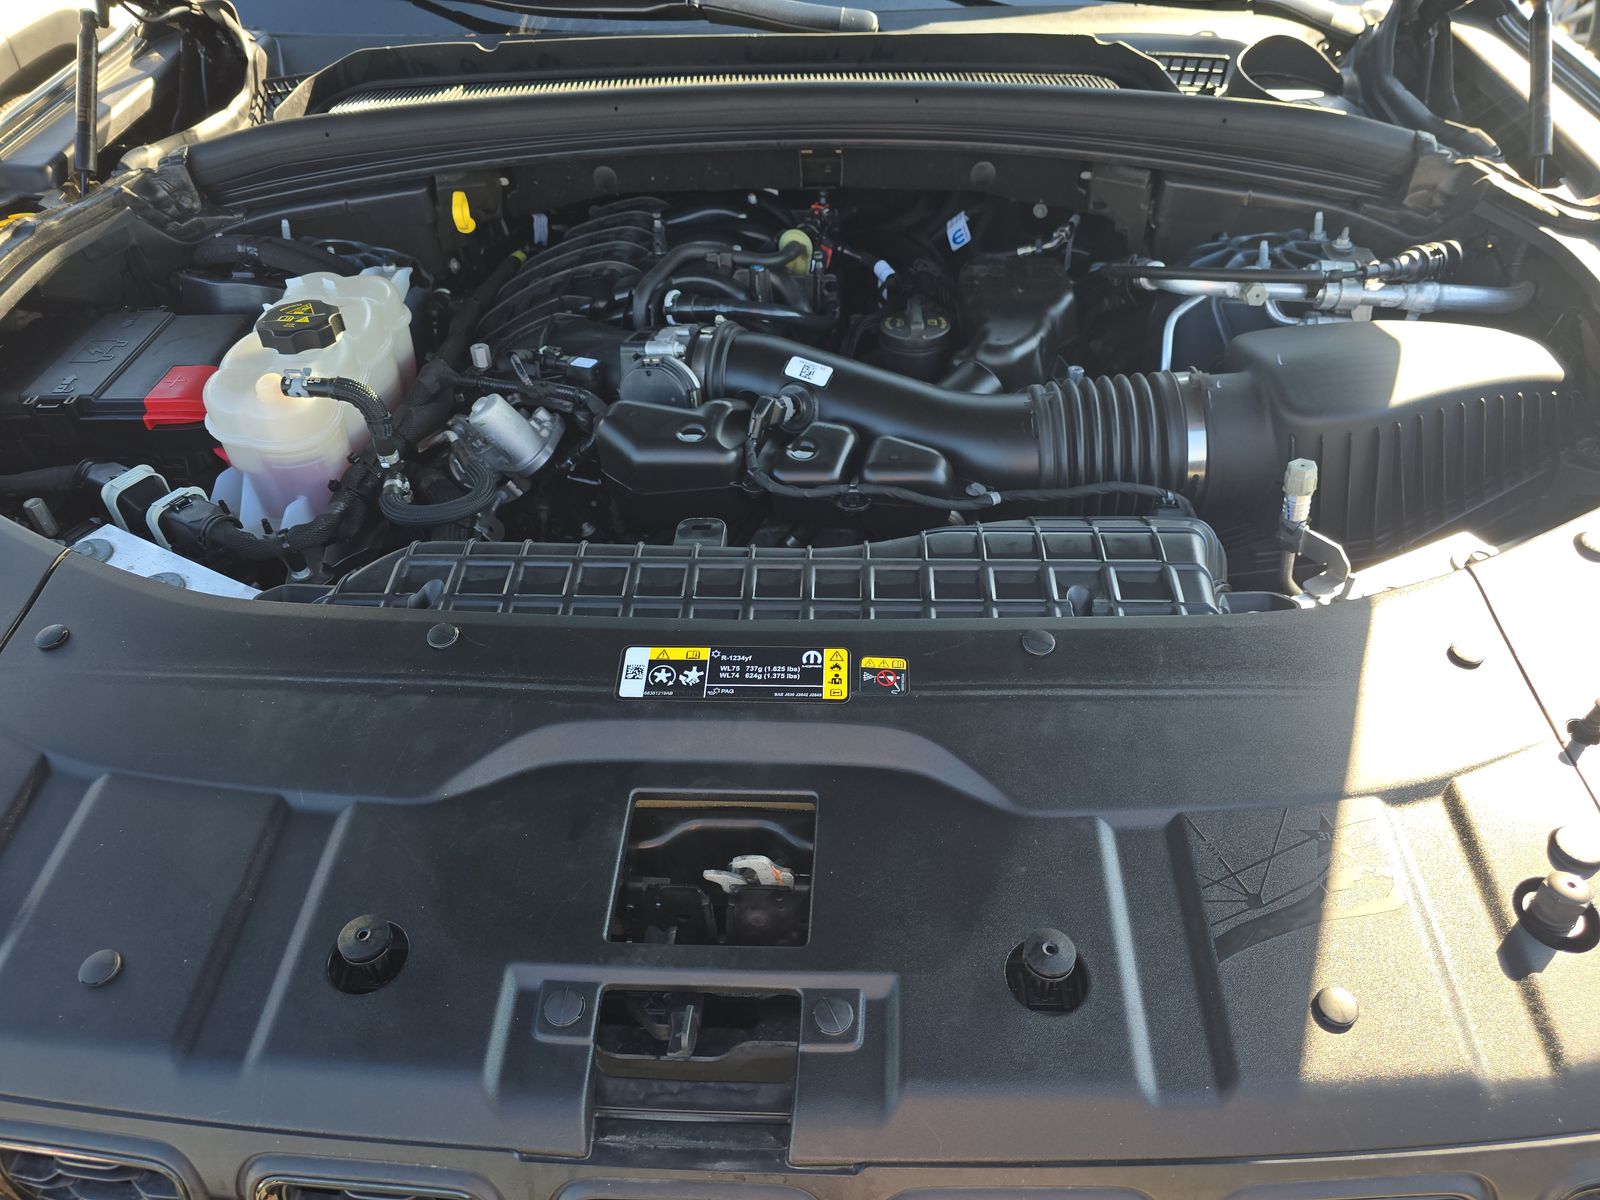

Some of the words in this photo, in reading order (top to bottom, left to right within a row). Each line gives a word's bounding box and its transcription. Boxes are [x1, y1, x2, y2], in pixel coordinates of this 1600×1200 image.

[721, 654, 752, 662] R-1234yf
[745, 665, 763, 673] 737g
[764, 665, 786, 673] (1.625
[786, 665, 801, 673] lbs)
[745, 672, 763, 680] 624g
[764, 672, 786, 680] (1.375
[786, 672, 801, 680] lbs)
